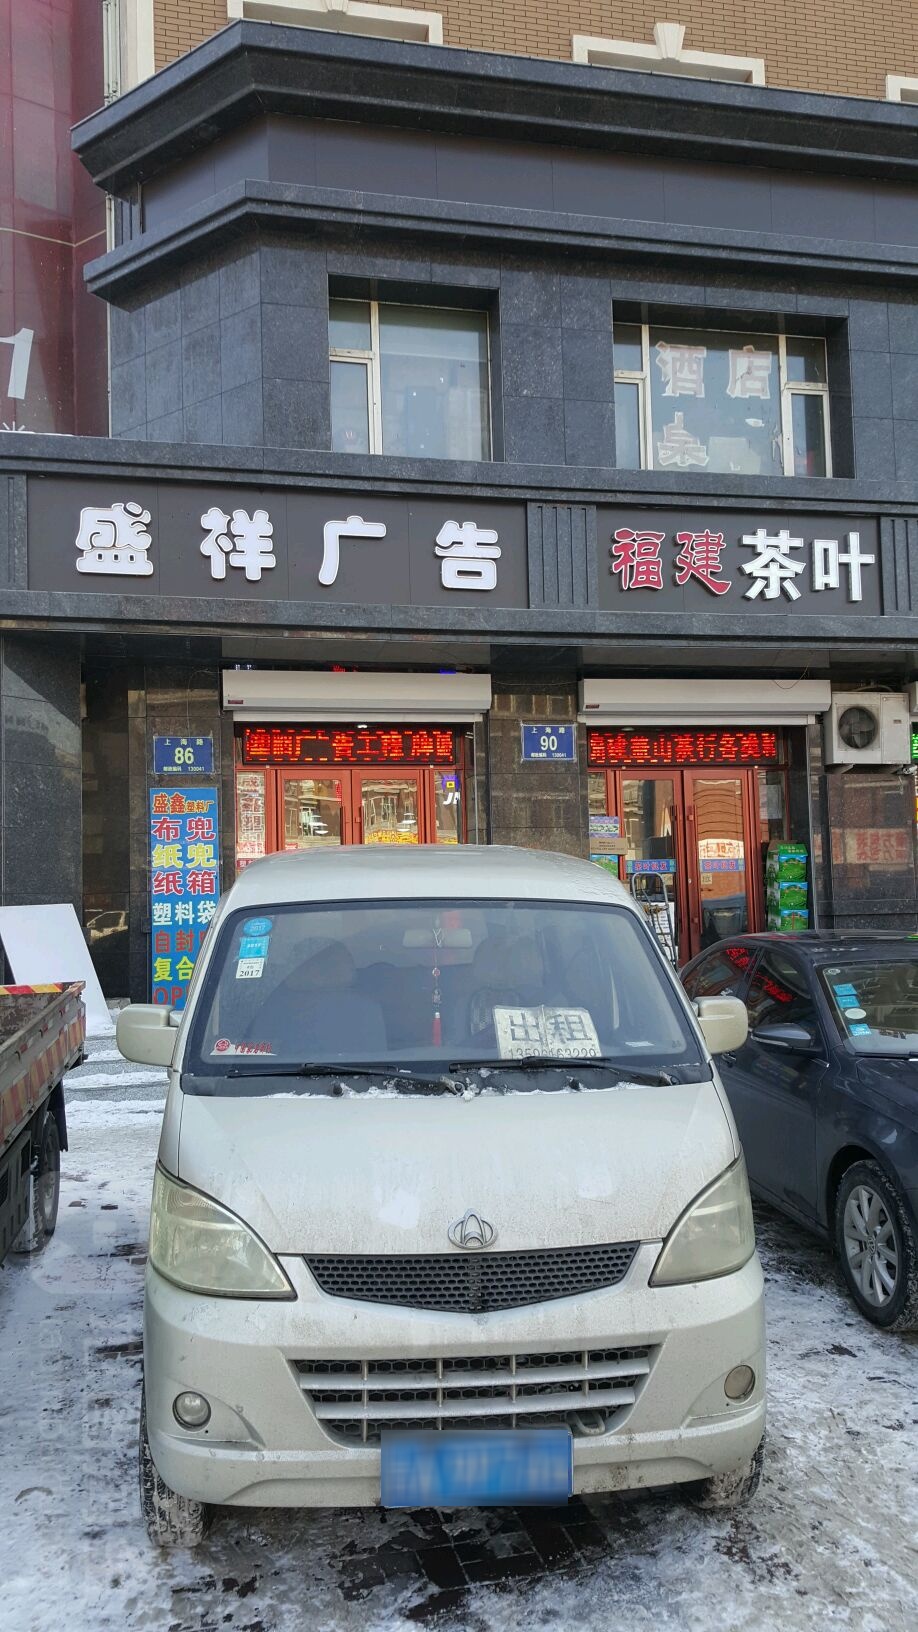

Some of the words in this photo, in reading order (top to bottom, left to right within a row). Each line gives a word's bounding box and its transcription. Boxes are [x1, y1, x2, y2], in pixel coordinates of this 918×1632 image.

[655, 341, 772, 399] 酒店
[75, 501, 503, 592] 盛祥广告
[609, 527, 877, 603] 福建茶叶
[164, 738, 204, 746] 上海路
[531, 726, 566, 734] 上海路
[174, 747, 195, 764] 86
[540, 735, 558, 751] 90
[151, 816, 217, 842] 布兜
[152, 843, 217, 869] 纸兜
[153, 869, 217, 895] 纸箱
[152, 900, 217, 925] 塑料袋
[155, 929, 206, 954] 自封
[239, 969, 260, 977] 2017
[153, 986, 190, 1006] OP
[508, 1012, 592, 1044] 出租
